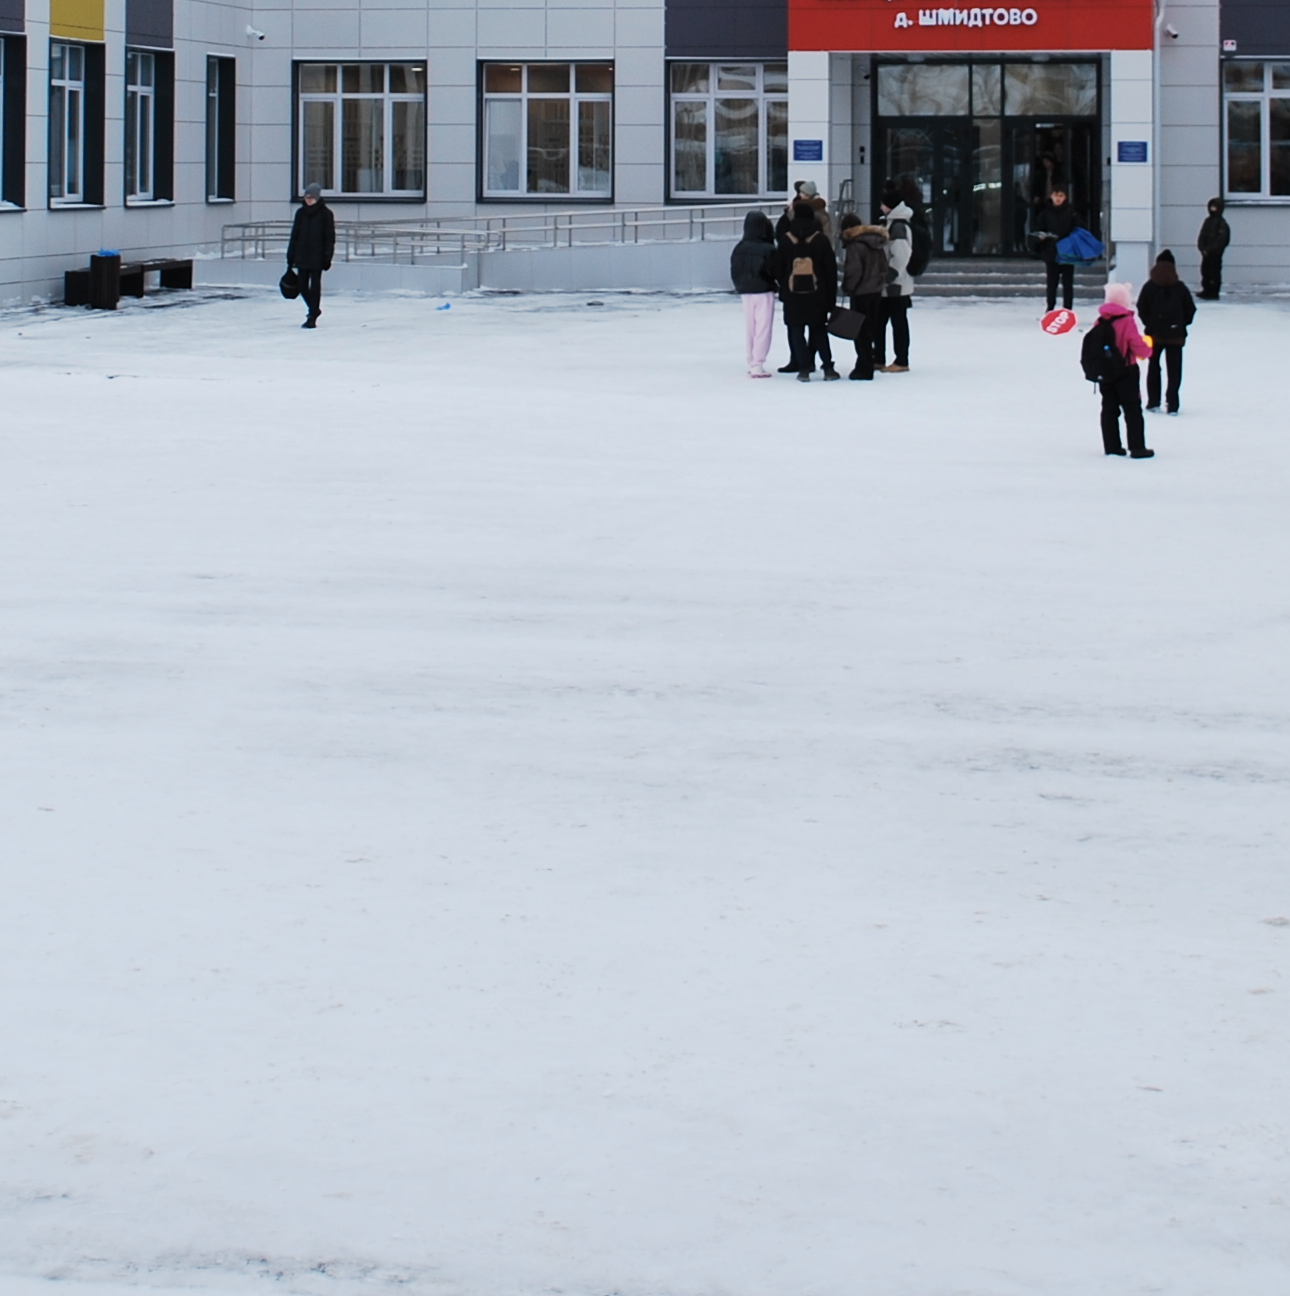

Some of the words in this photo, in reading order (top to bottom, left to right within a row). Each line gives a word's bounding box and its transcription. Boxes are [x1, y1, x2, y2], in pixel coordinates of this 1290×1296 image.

[894, 11, 914, 29] д.
[918, 8, 1038, 28] ШМИДТОВО
[1045, 311, 1069, 334] STOP
